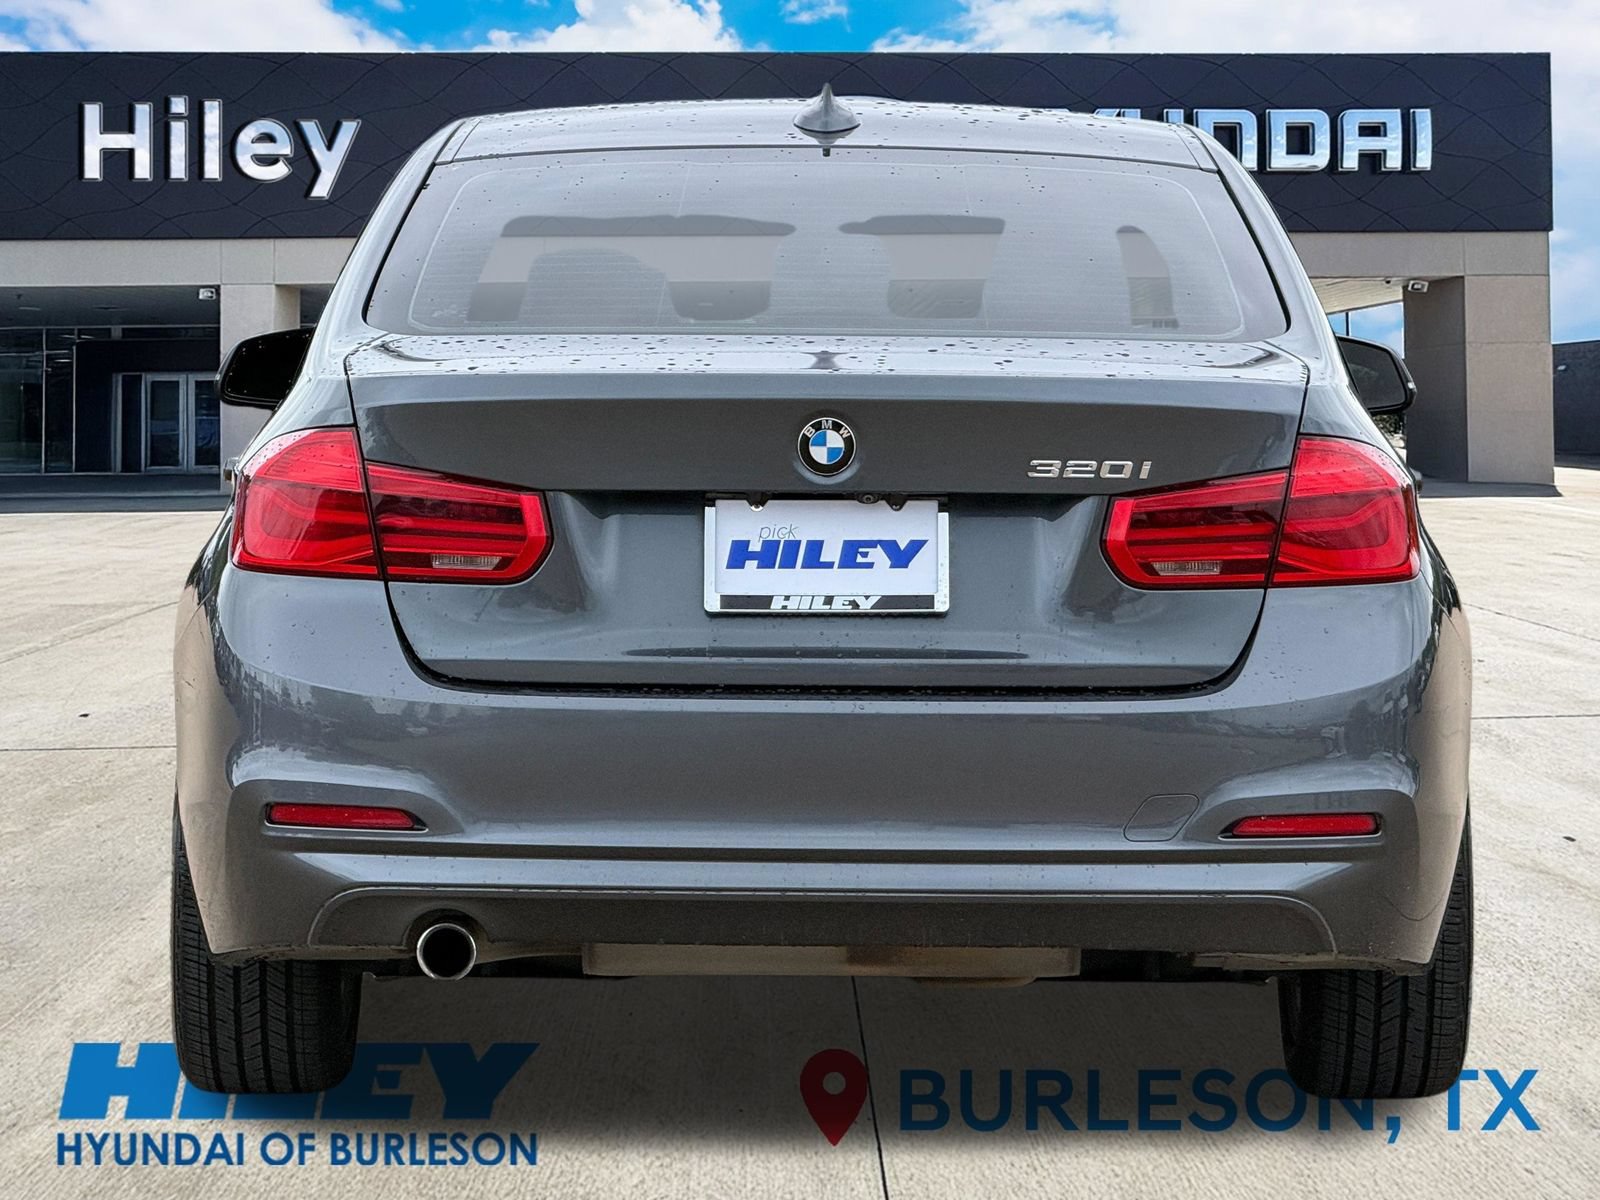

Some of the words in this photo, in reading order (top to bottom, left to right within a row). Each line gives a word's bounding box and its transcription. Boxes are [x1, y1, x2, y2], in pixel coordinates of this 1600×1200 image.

[79, 95, 361, 199] Hiley
[803, 419, 851, 439] BMW
[757, 523, 798, 543] pick
[725, 539, 929, 569] HILEY
[770, 595, 882, 610] HILEY
